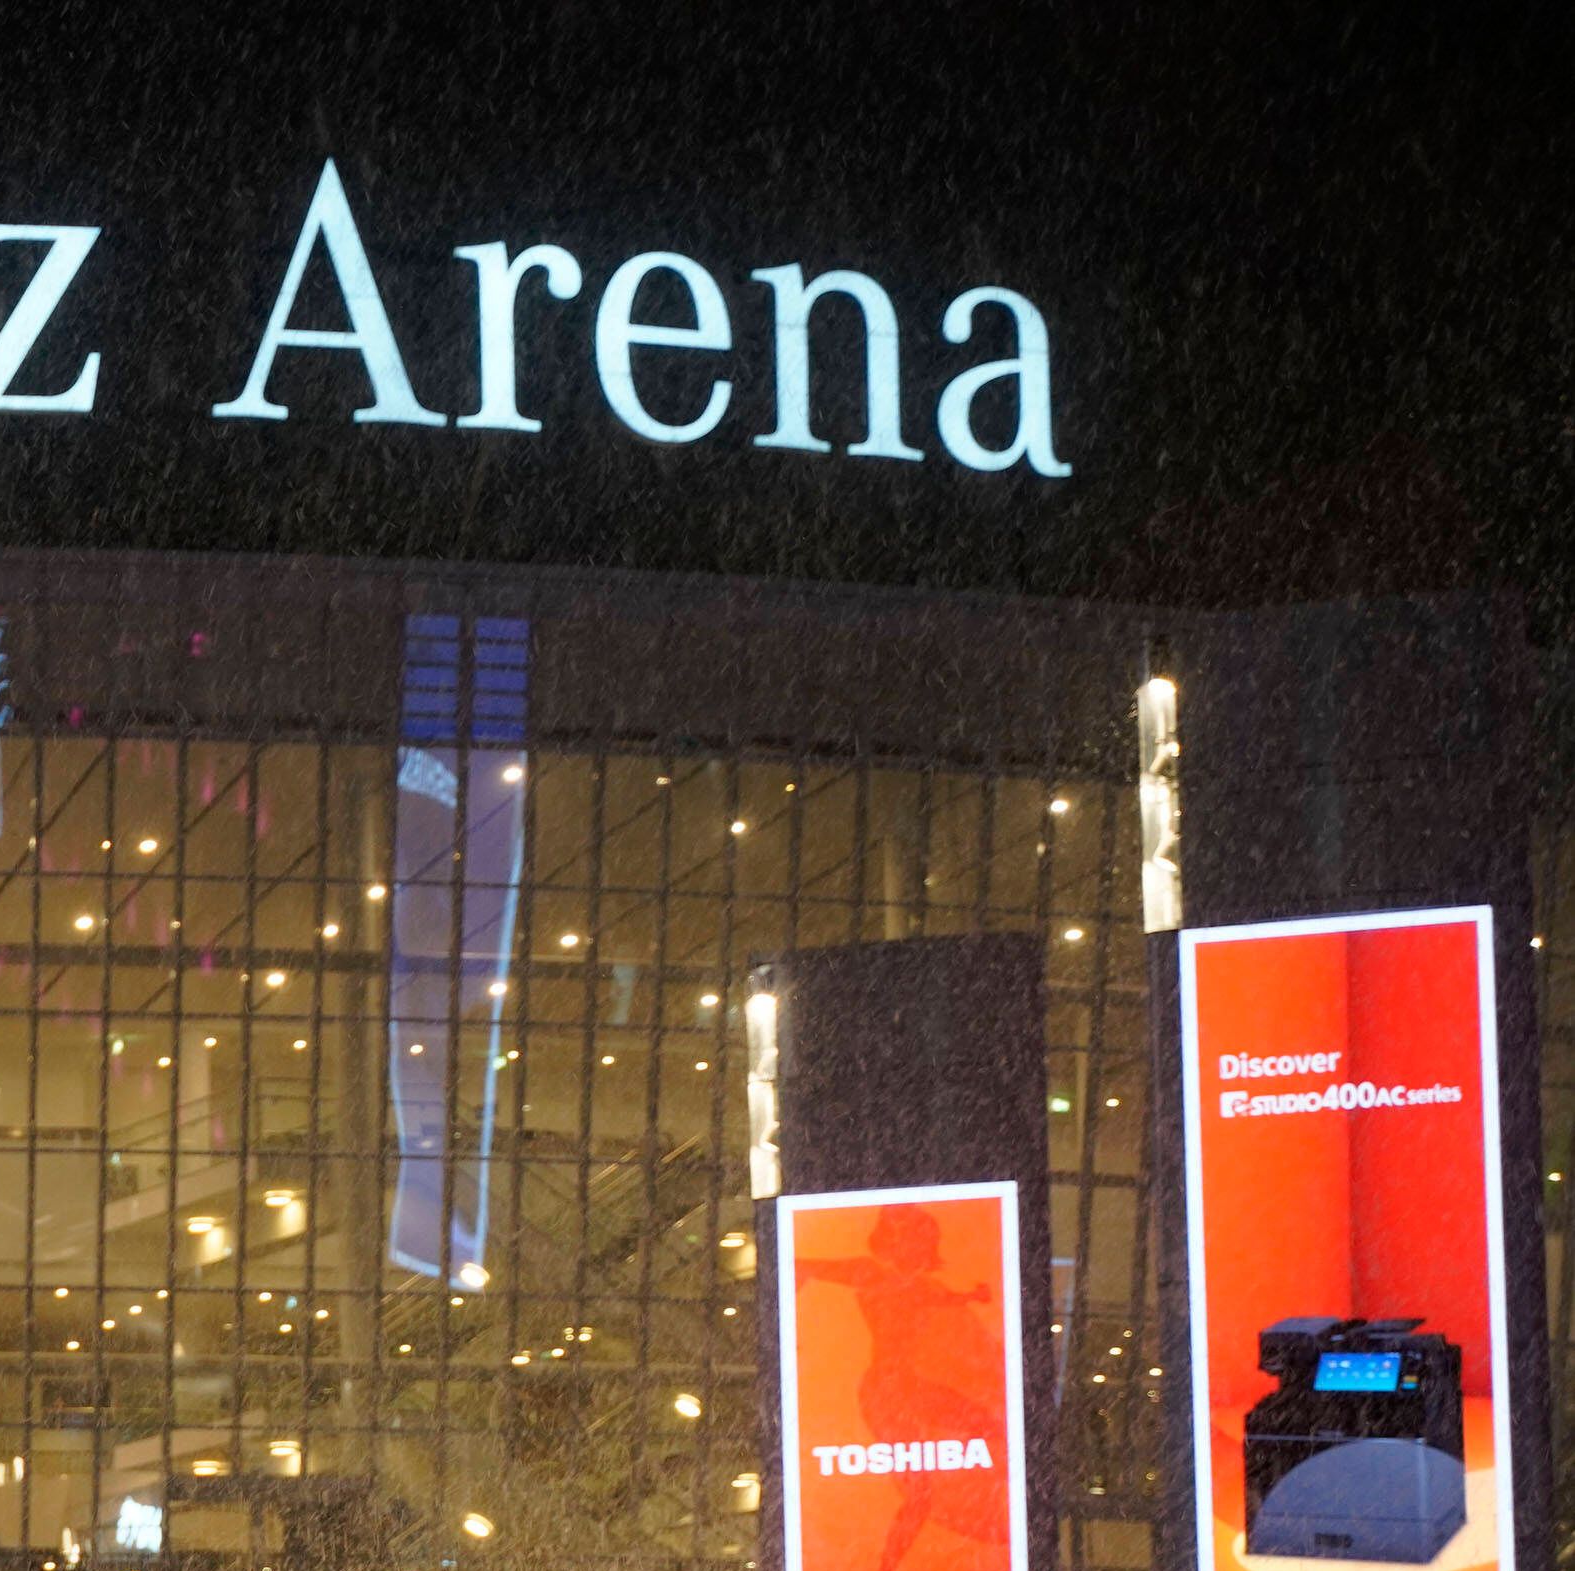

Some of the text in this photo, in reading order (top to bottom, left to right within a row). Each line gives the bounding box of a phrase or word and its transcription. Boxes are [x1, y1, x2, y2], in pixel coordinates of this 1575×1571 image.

[212, 156, 1070, 479] Arena
[1217, 1050, 1343, 1082] Discover
[1407, 1082, 1464, 1106] series
[810, 1437, 995, 1478] TOSHIBA
